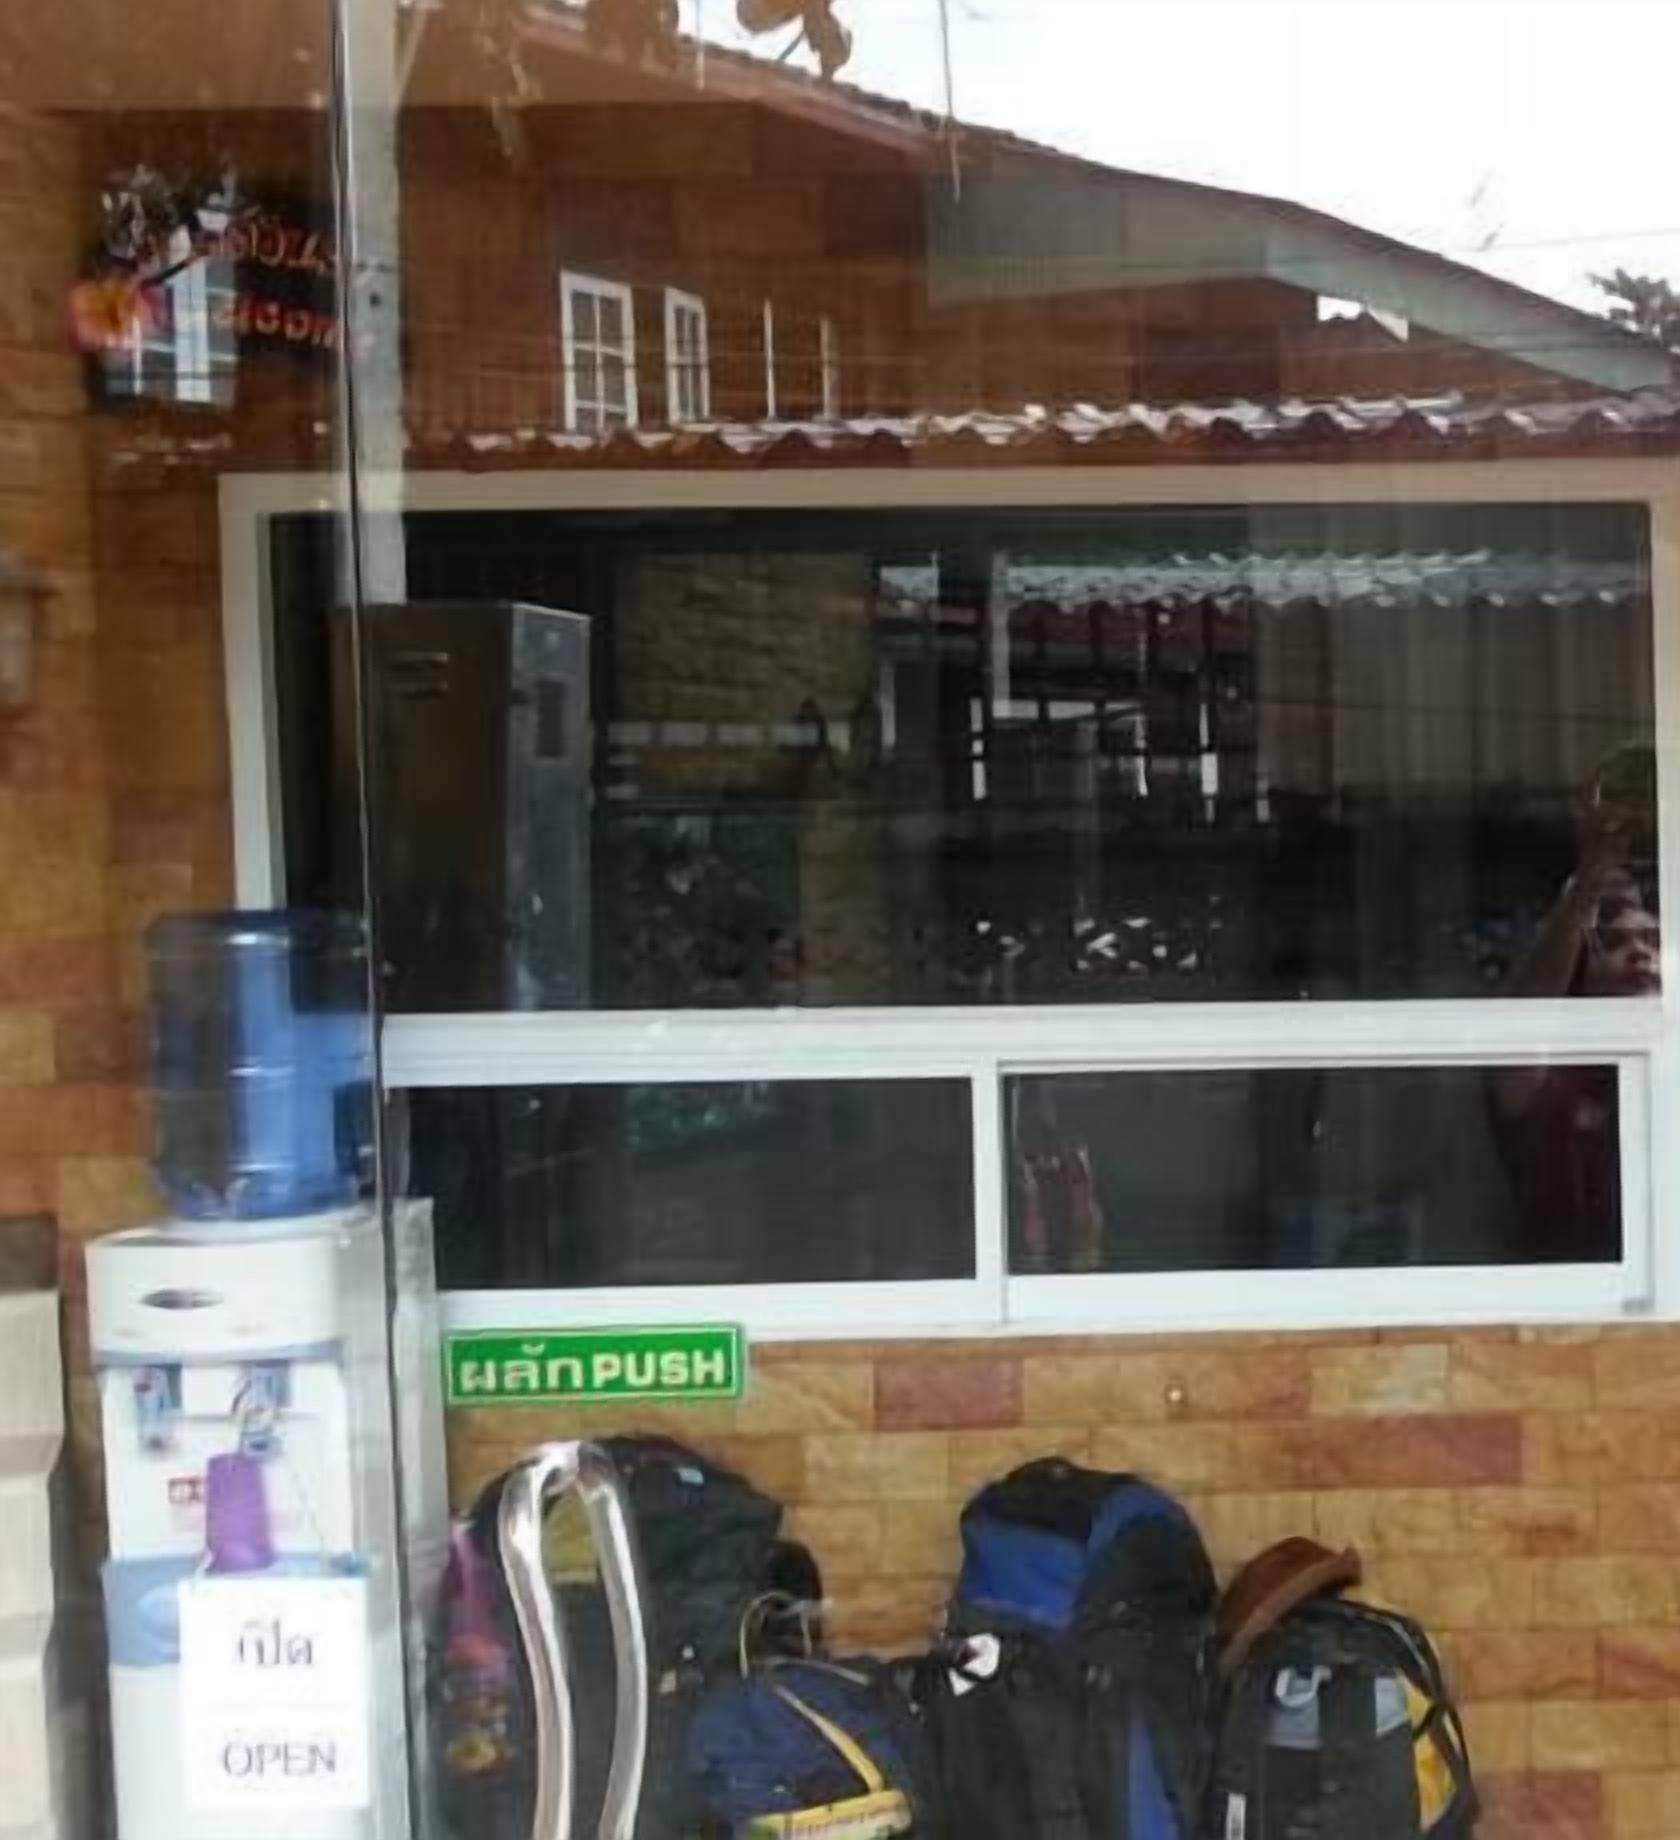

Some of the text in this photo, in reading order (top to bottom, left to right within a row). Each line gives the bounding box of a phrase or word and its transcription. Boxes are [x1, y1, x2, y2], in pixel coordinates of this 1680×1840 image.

[459, 1343, 726, 1393] ผลัก PUSH
[222, 1741, 338, 1776] OPEN
